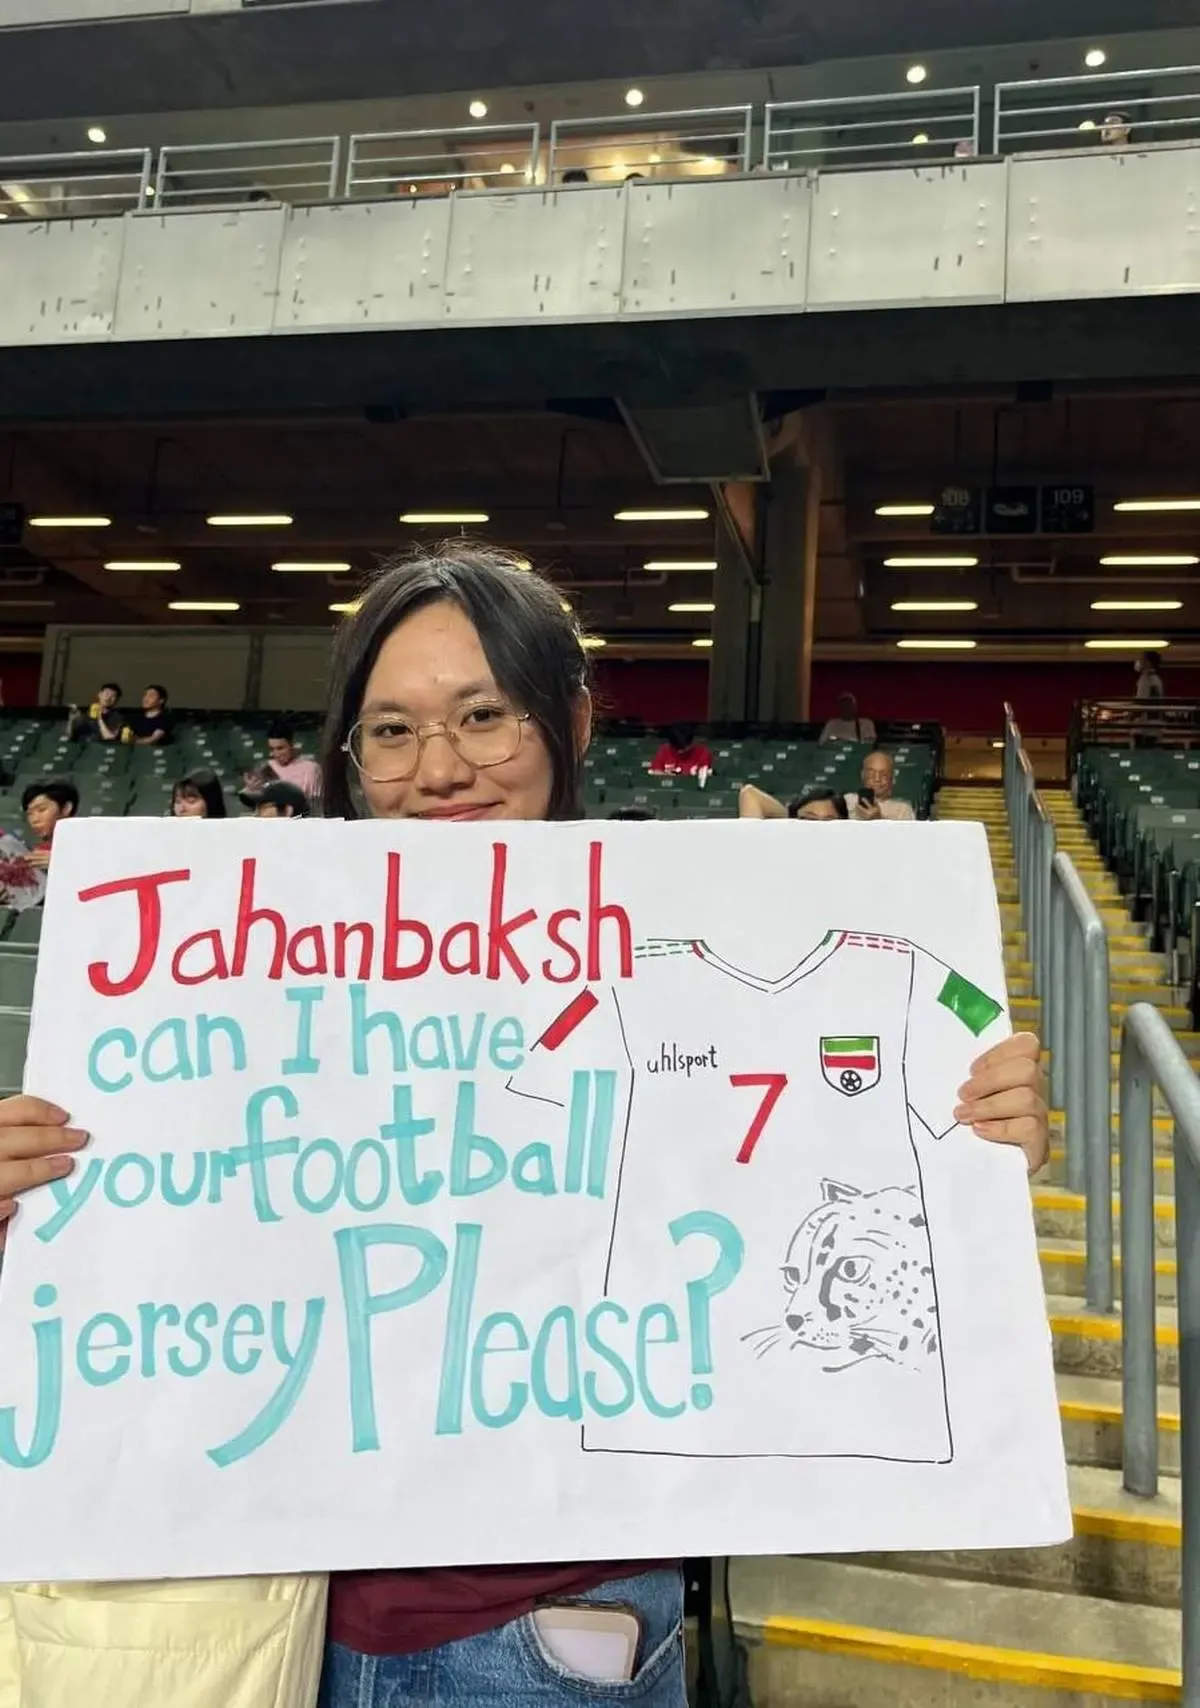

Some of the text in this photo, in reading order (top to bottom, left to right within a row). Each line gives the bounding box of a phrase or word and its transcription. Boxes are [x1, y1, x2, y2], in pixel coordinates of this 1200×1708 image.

[1054, 488, 1084, 504] 109
[78, 842, 633, 996] Jahanbaksh
[88, 982, 525, 1094] can I have
[646, 1041, 718, 1078] uhlsport
[34, 1069, 617, 1243] your football
[729, 1073, 788, 1164] 7
[0, 1210, 745, 1469] jersey Please?
